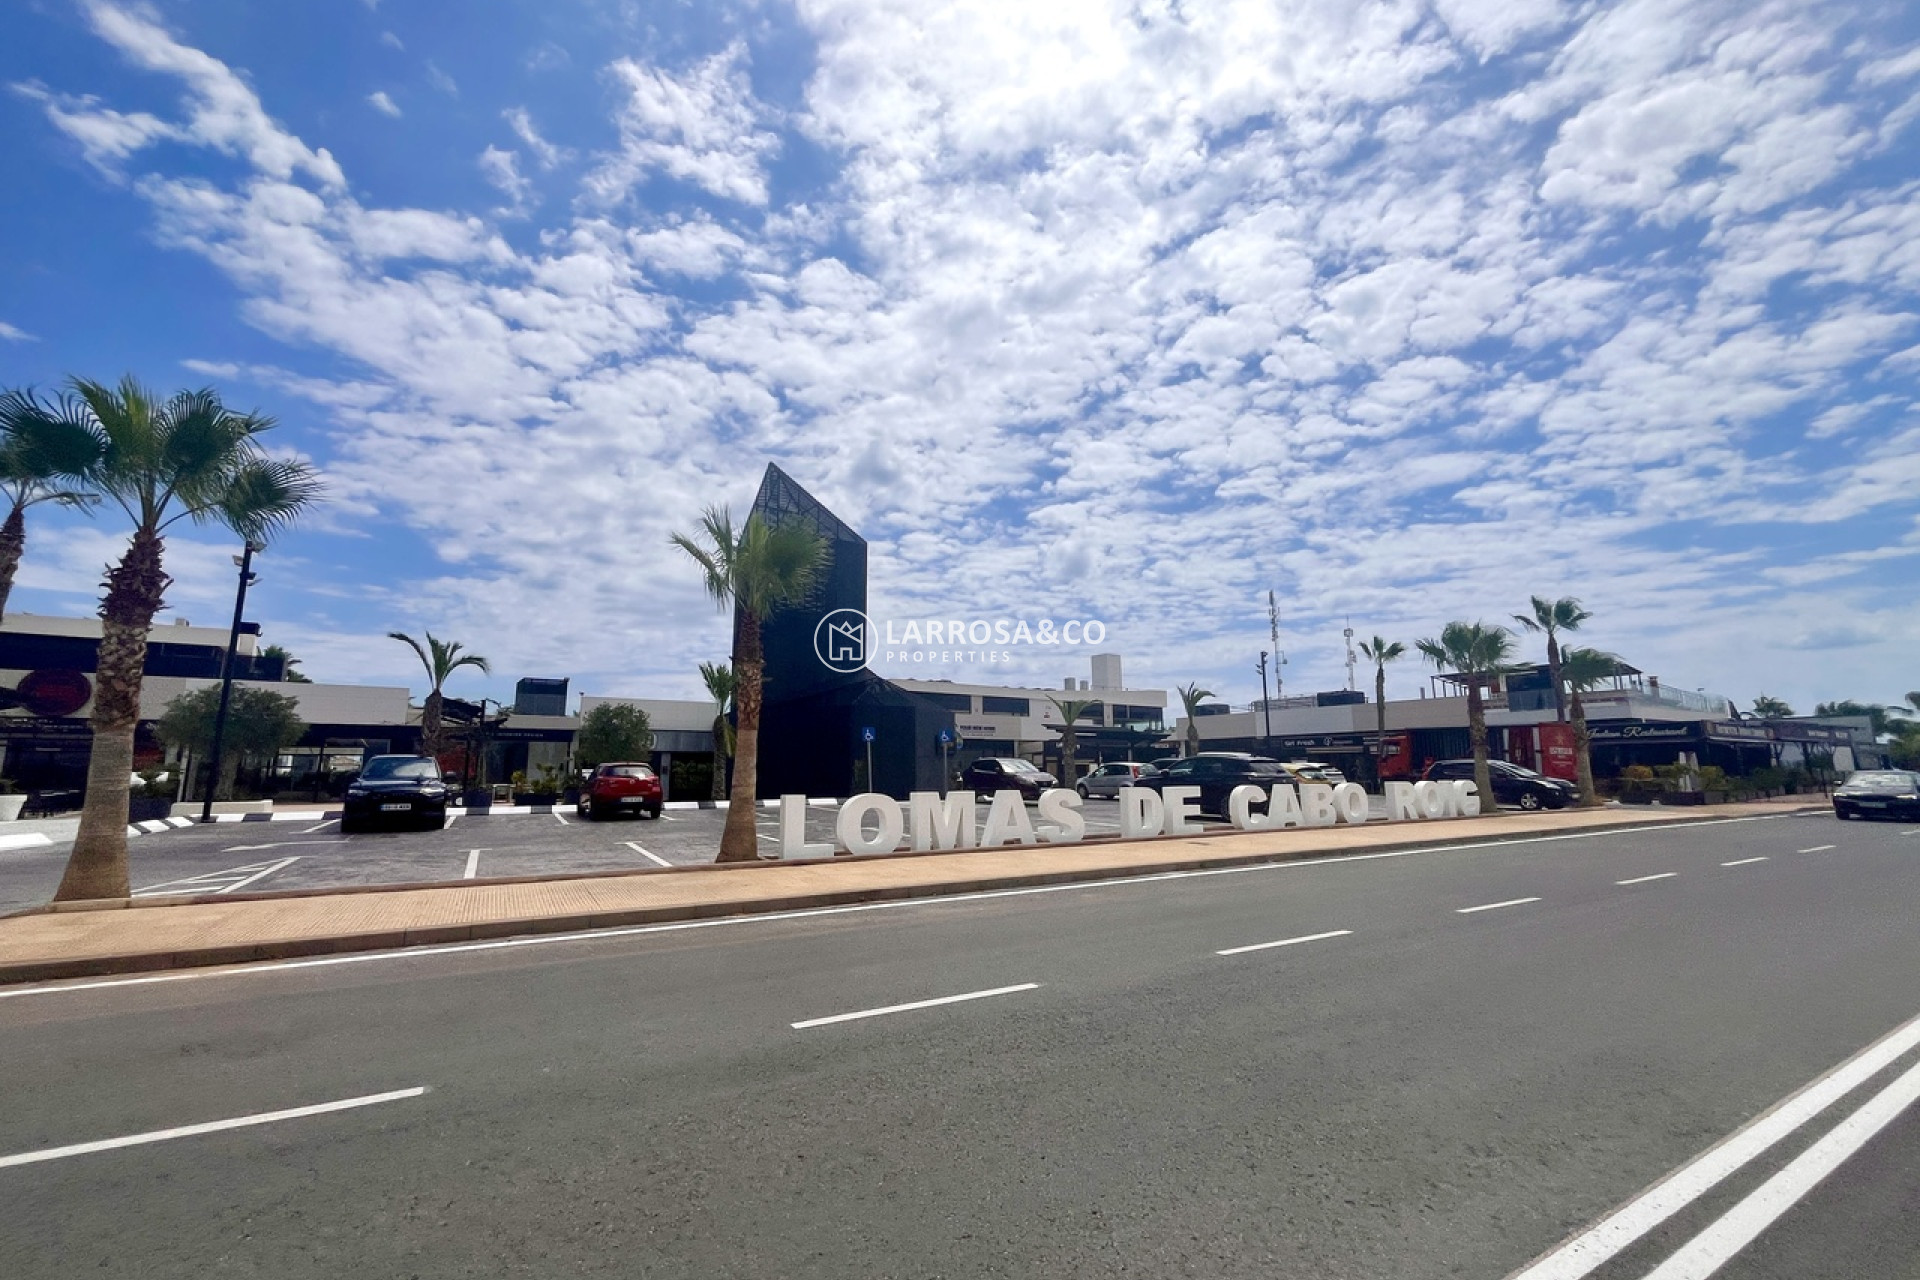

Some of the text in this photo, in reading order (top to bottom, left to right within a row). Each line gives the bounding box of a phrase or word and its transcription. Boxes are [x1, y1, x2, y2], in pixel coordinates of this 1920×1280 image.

[1623, 726, 1688, 738] Restaurant
[779, 780, 1481, 860] LOMAS DE CABO ROIG
